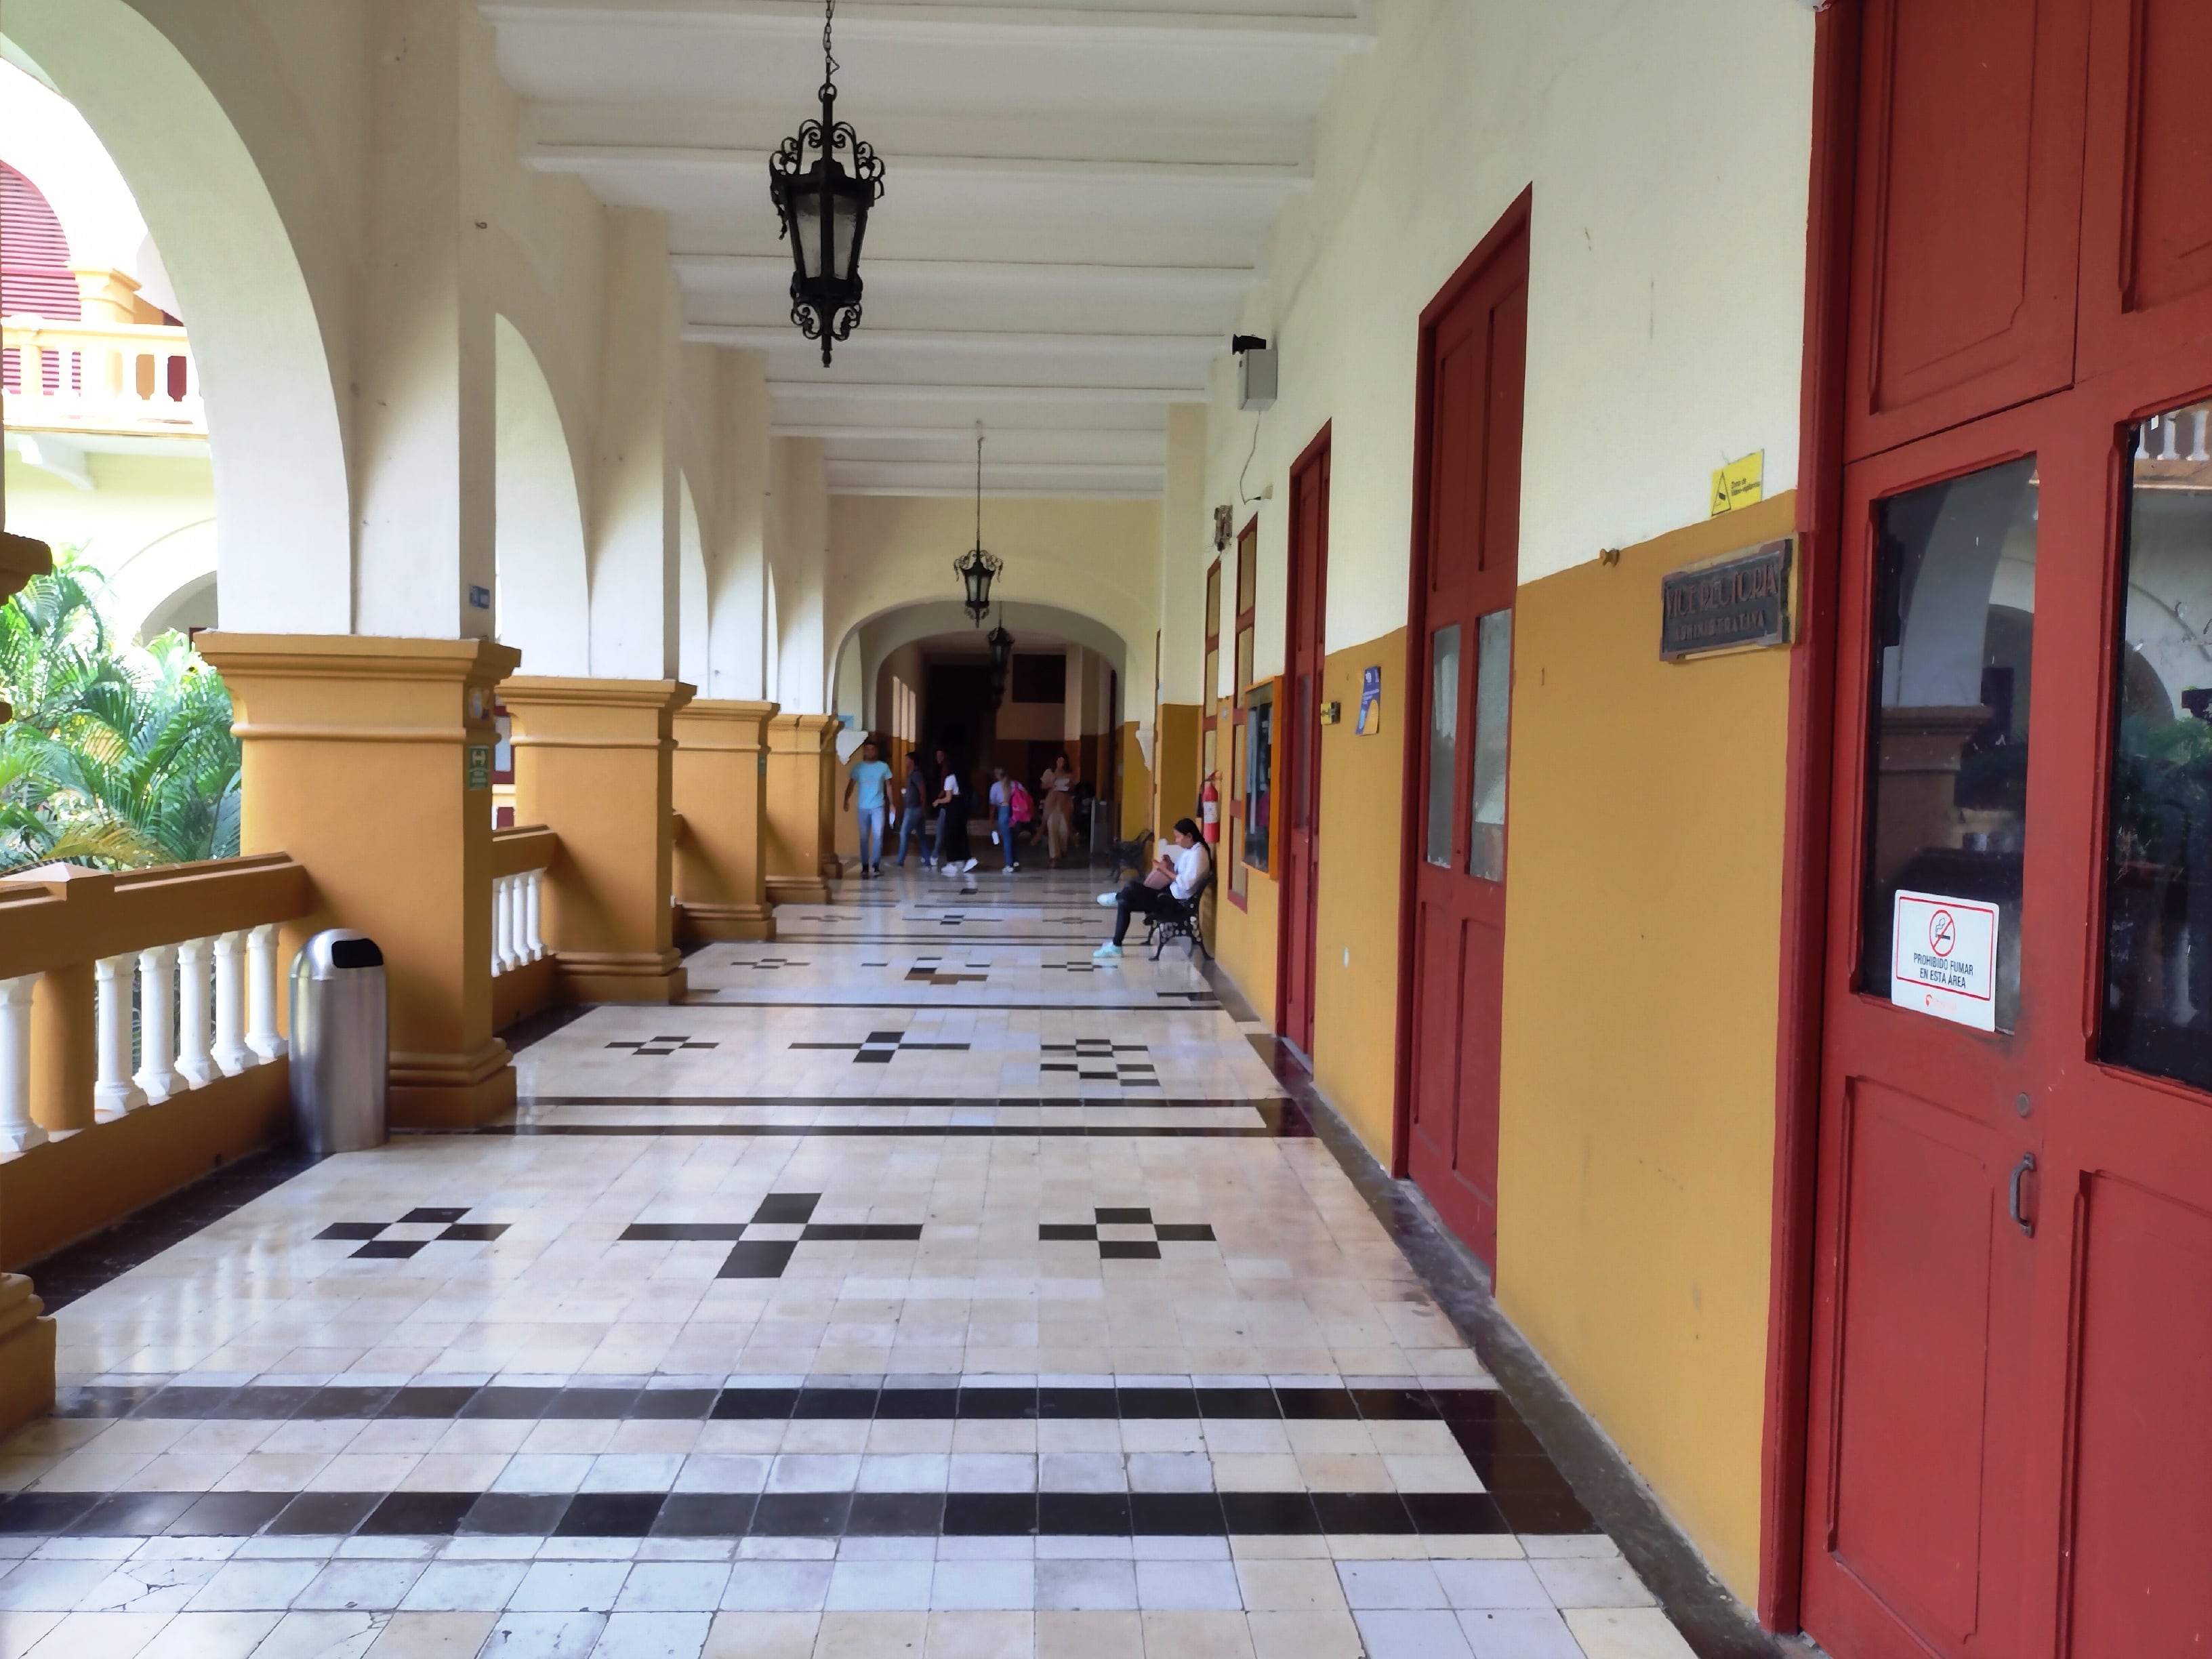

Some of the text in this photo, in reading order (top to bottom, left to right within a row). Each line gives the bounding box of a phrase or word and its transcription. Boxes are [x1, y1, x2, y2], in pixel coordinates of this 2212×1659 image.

[1913, 953, 1973, 976] PROHIBIDO FUMAR
[1920, 968, 1928, 979] EN
[1930, 970, 1946, 984] ESTA
